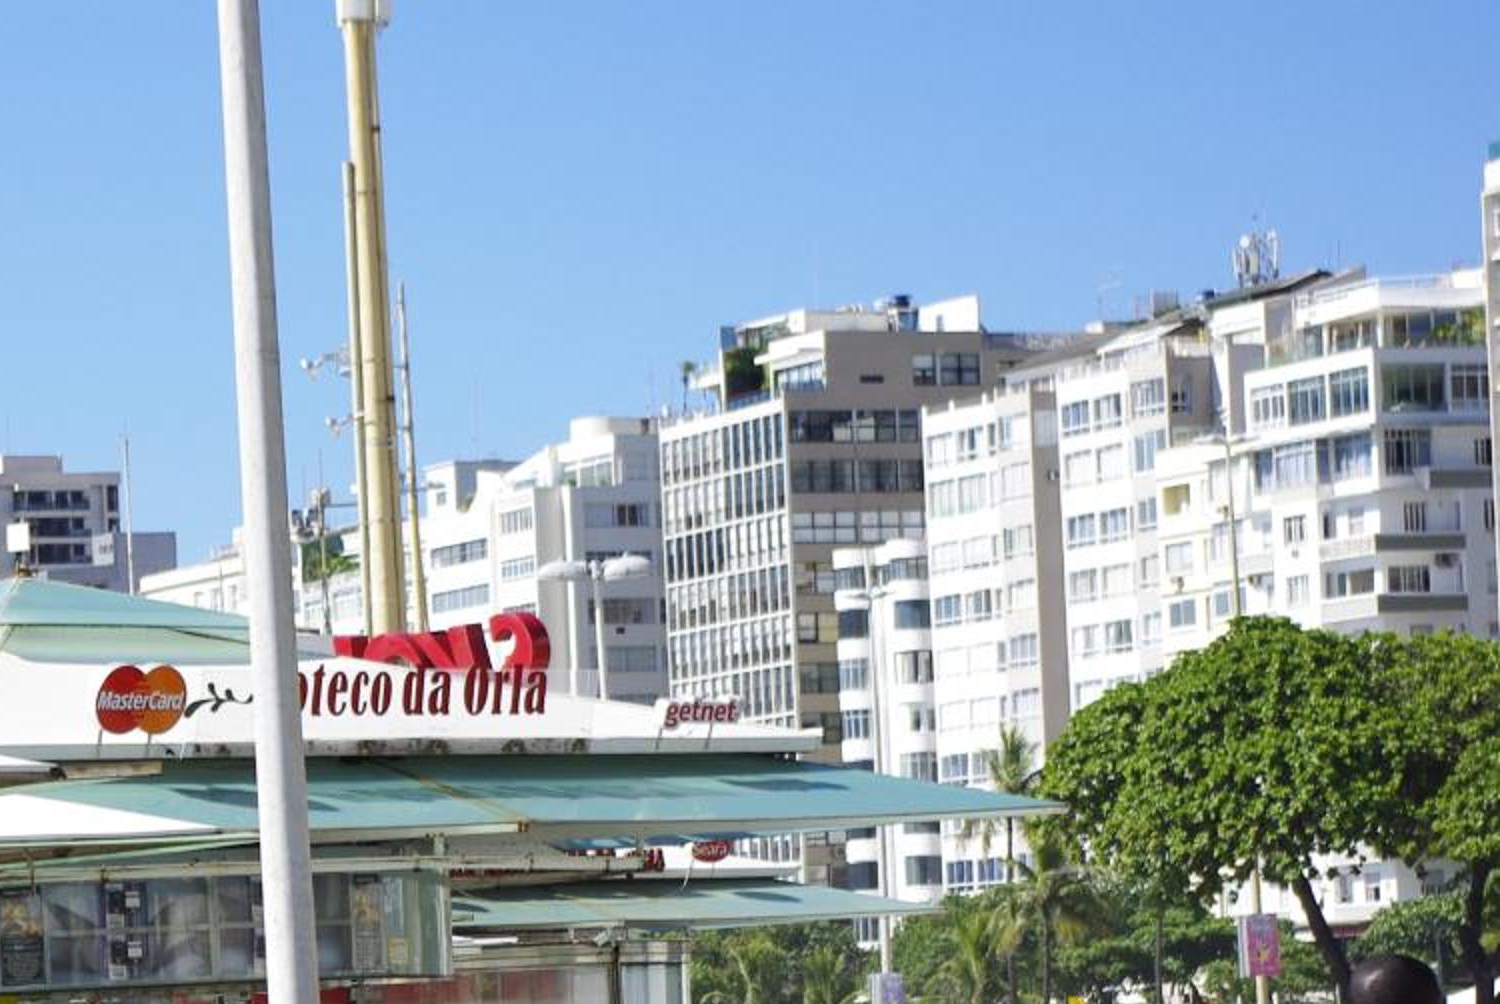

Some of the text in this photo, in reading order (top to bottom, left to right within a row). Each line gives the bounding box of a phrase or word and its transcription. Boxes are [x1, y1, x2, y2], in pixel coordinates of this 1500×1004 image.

[98, 689, 184, 711] MasterCard
[297, 663, 548, 717] oteco da Orla
[664, 700, 737, 728] getnet
